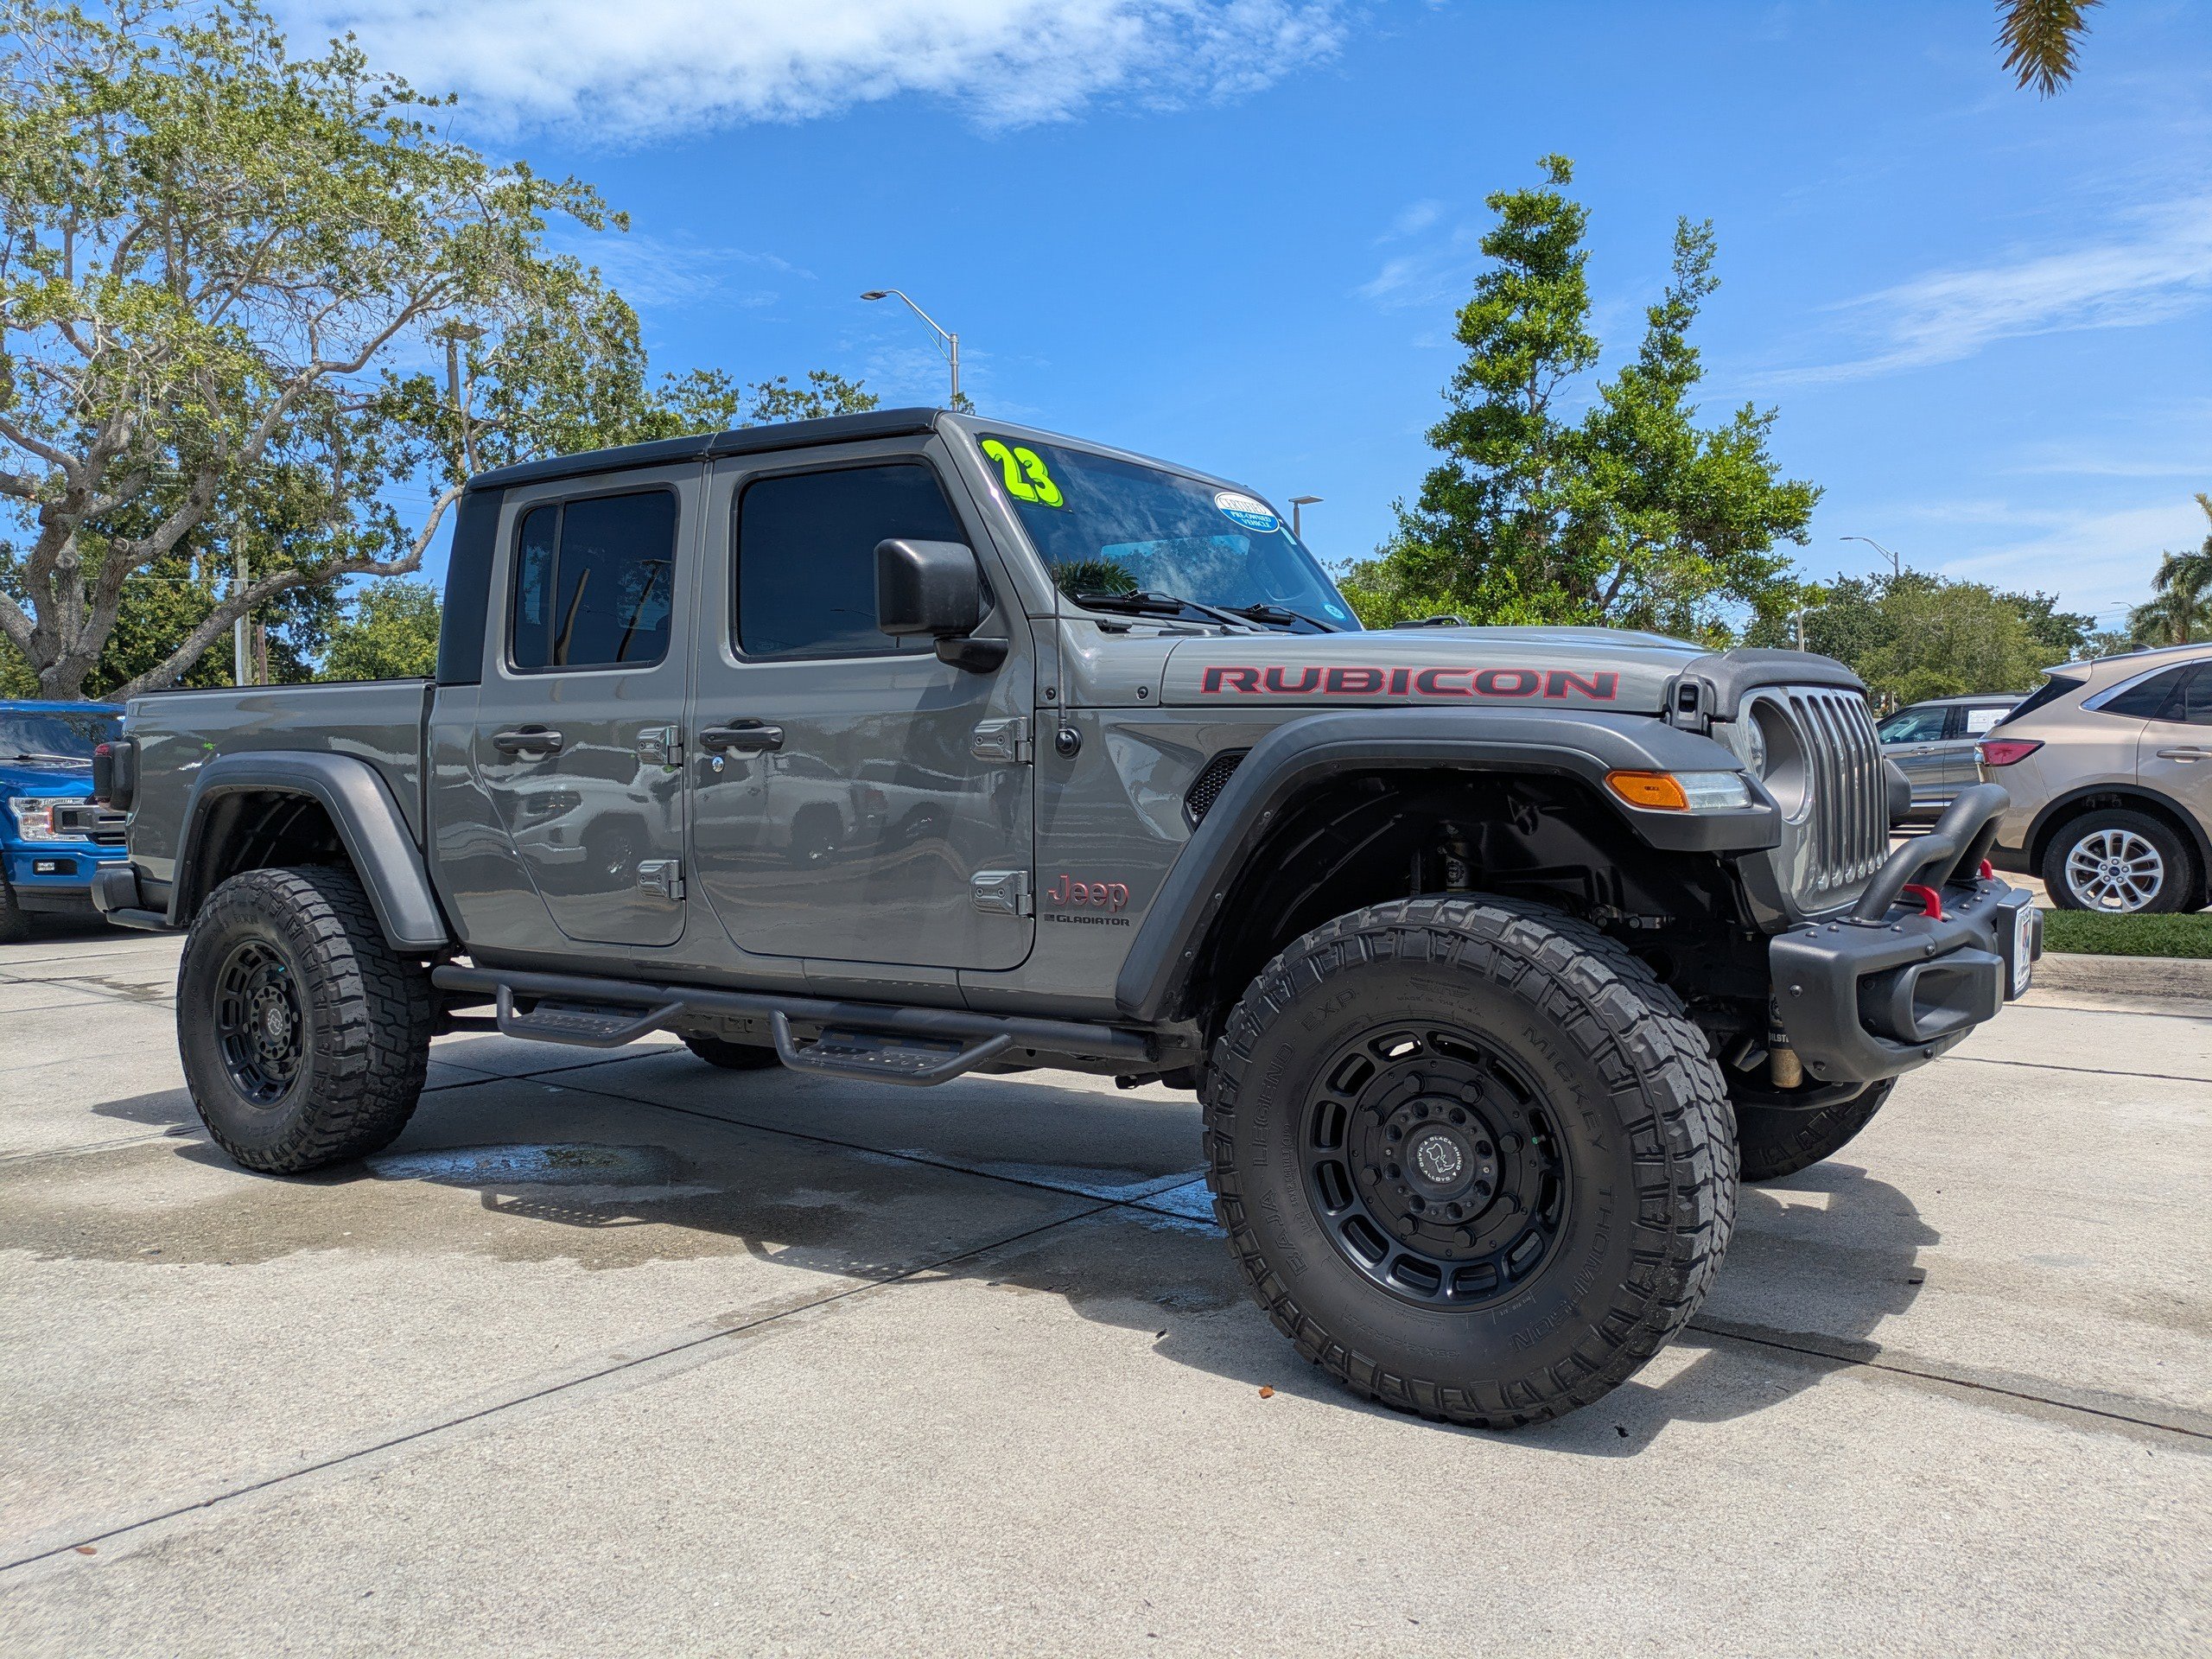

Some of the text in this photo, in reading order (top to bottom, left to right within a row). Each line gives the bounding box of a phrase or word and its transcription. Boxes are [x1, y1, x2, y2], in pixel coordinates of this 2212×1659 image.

[982, 439, 1064, 507] 23
[1219, 498, 1268, 514] CERTIFIED
[1230, 511, 1272, 523] PRE-OWNED
[1241, 518, 1272, 528] VEHICLE
[1201, 666, 1619, 701] RUBICON
[1047, 874, 1129, 912] Jeep
[1056, 915, 1130, 926] GLADIATOR
[1300, 988, 1356, 1033] EXP
[1253, 1042, 1295, 1167] LEGEND
[1429, 1136, 1462, 1171] BLACK RHINO
[1423, 1170, 1451, 1182] ALLOYS
[1509, 1023, 1617, 1354] MICKEY THOMPSON
[1260, 1187, 1309, 1277] BAJA
